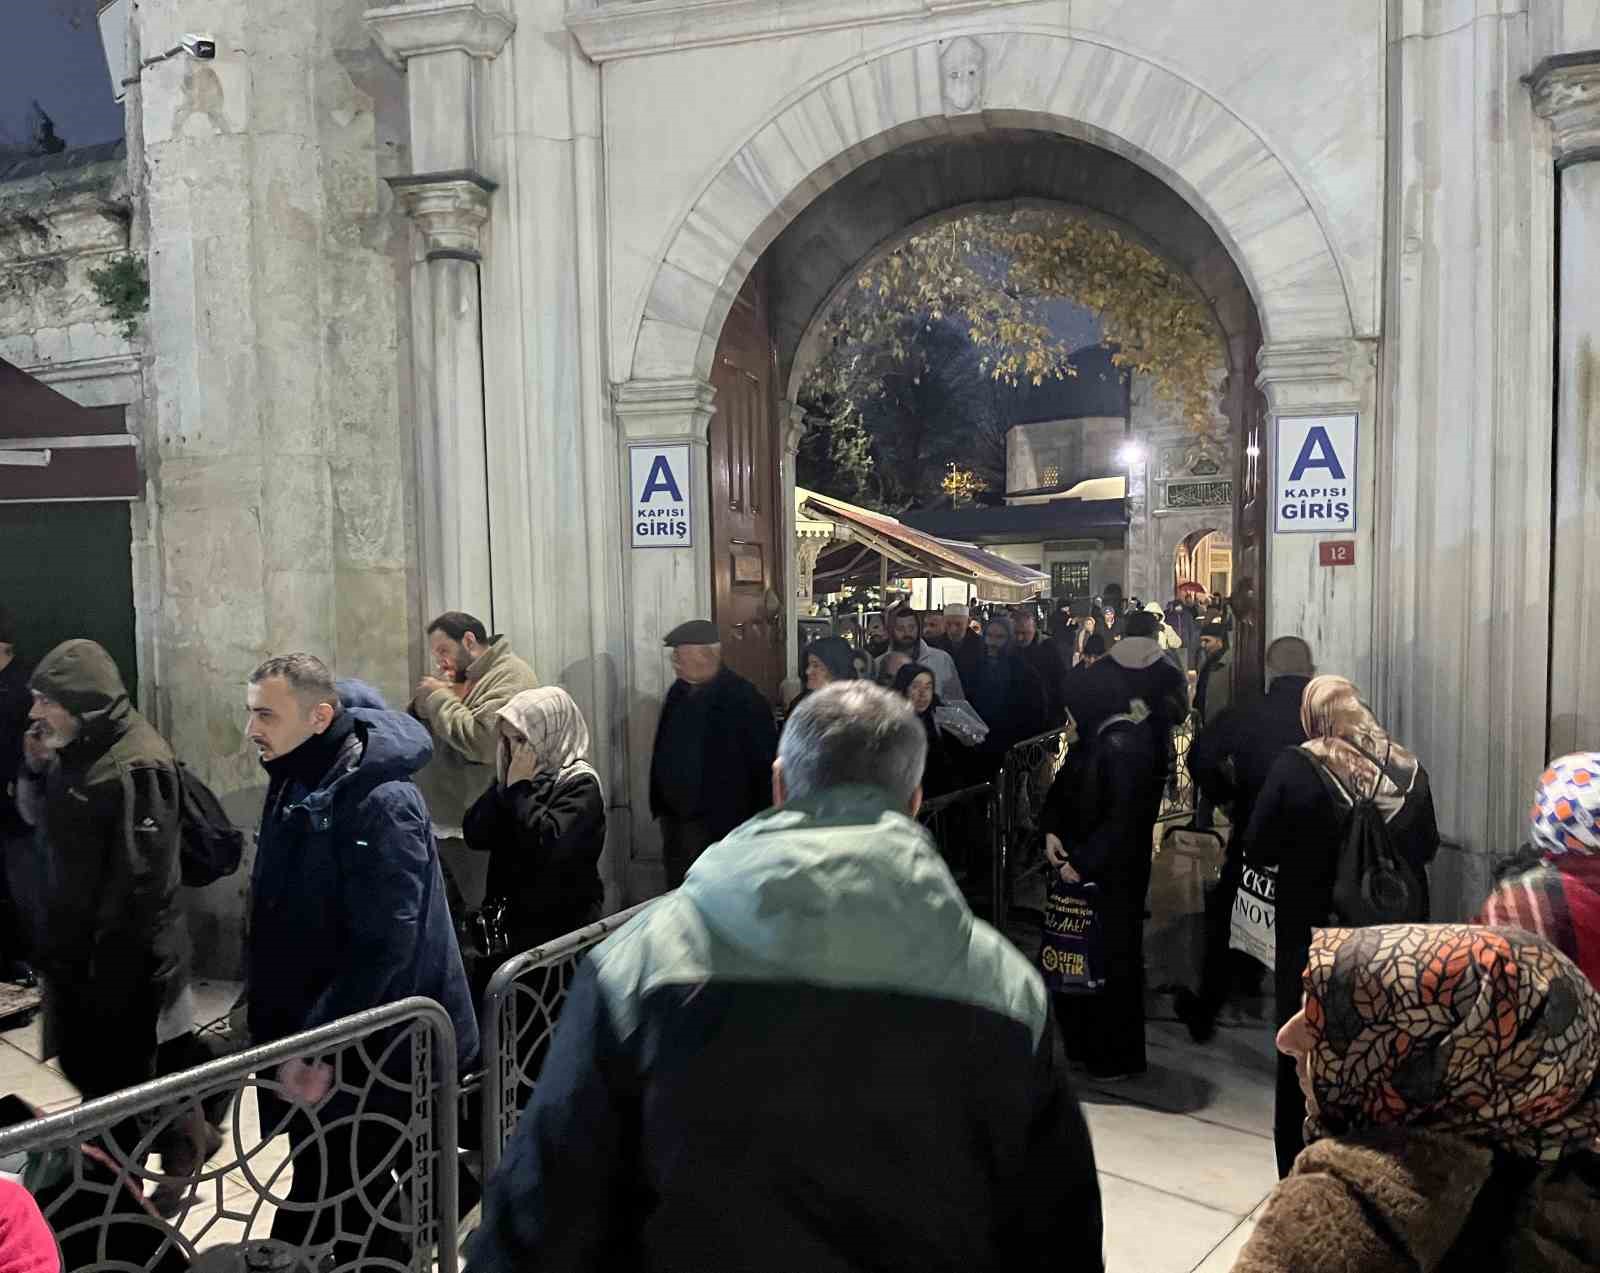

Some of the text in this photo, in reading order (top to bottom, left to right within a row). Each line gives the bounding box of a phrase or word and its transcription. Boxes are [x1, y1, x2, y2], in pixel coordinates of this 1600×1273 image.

[1288, 426, 1346, 481] A
[640, 455, 683, 503] A
[1284, 487, 1346, 498] KAPISI
[637, 508, 684, 518] KAPISI
[1281, 499, 1350, 522] GİRİŞ
[636, 518, 687, 539] GİRİŞ
[1329, 547, 1346, 560] 12
